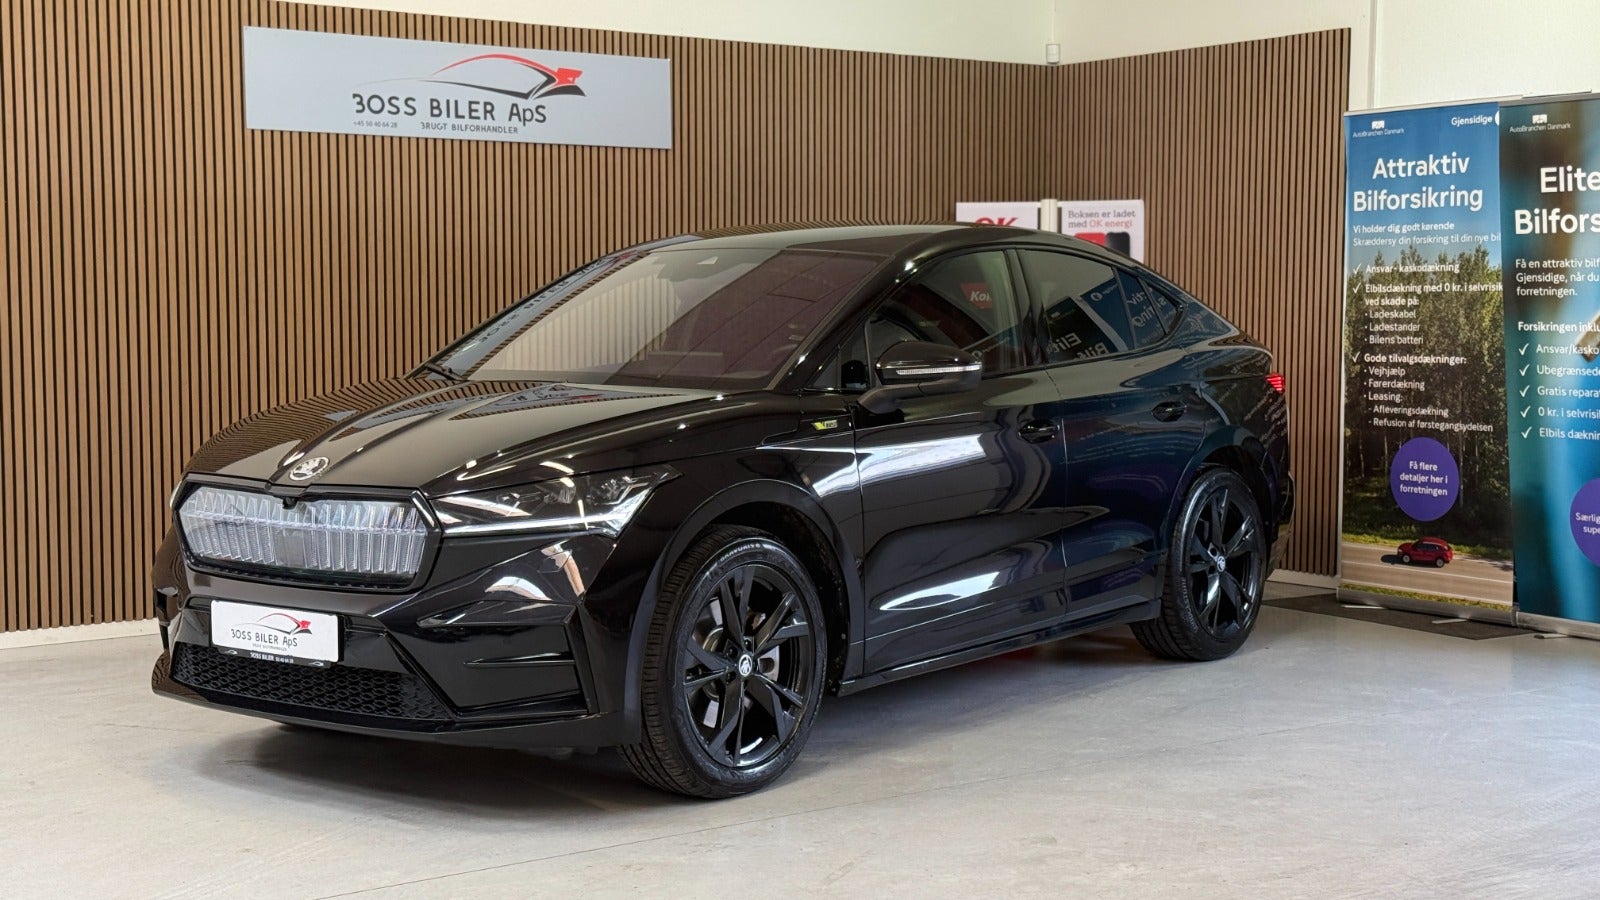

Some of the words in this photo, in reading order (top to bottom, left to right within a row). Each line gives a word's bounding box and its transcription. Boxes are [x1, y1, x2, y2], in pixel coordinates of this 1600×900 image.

[430, 98, 495, 121] BILER
[508, 103, 547, 127] ApS
[1451, 115, 1493, 127] Gjensidige
[452, 123, 518, 134] BILFORHANDLER
[1509, 125, 1546, 133] AutoBranchen
[1547, 123, 1571, 131] Danmark
[1372, 151, 1470, 179] Attraktiv
[1540, 165, 1600, 193] Elite
[1353, 185, 1483, 212] Bilforsikring
[1068, 210, 1099, 219] Boksen
[1113, 210, 1136, 218] ladet
[1068, 220, 1087, 228] med
[1089, 220, 1103, 228] OK
[1104, 220, 1133, 229] energi
[1514, 207, 1600, 235] Bilfors
[1353, 225, 1361, 233] Vi
[1362, 225, 1386, 233] holder
[1387, 224, 1400, 234] dig
[1401, 223, 1420, 234] godt
[1421, 222, 1455, 231] kørende
[1353, 237, 1396, 247] Skræddersy
[1412, 235, 1449, 245] forsikring
[1450, 234, 1459, 243] til
[1461, 233, 1473, 242] din
[1474, 235, 1489, 244] nye
[1399, 263, 1460, 274] kaskodækning
[1515, 259, 1527, 269] Få
[1528, 261, 1540, 269] en
[1542, 258, 1583, 269] attraktiv
[1515, 272, 1568, 285] Gjensidige,
[1569, 272, 1586, 282] når
[1587, 272, 1600, 282] du
[1365, 284, 1422, 294] Elbilsdækning
[1423, 283, 1442, 292] med
[1444, 283, 1450, 292] 0
[1452, 283, 1463, 292] kr.
[1516, 286, 1578, 298] forretningen.
[1365, 297, 1380, 306] ved
[1381, 297, 1405, 306] skade
[1407, 296, 1420, 307] på:
[1369, 310, 1416, 319] Ladeskabel
[1369, 323, 1420, 332] Ladestander
[1517, 321, 1577, 334] Forsikringen
[1369, 335, 1395, 344] Bilens
[1396, 335, 1424, 345] batteri
[1536, 344, 1599, 355] Ansvar/kasko
[1364, 353, 1387, 363] Gode
[1388, 353, 1467, 366] tilvalgsdækninger:
[1368, 366, 1406, 377] Vejhjælp
[1536, 365, 1600, 377] Ubegrænsed
[1368, 379, 1425, 391] Førerdækning
[1537, 386, 1567, 397] Gratis
[1373, 405, 1449, 418] Afleveringsdækning
[1538, 406, 1545, 417] 0
[1547, 407, 1559, 417] kr.
[1373, 417, 1407, 427] Refusion
[1407, 419, 1416, 428] af
[1539, 428, 1566, 439] Elbils
[1409, 461, 1418, 470] Få
[1419, 461, 1438, 471] flere
[1400, 472, 1429, 484] detaljer
[1430, 474, 1444, 483] her
[1400, 484, 1448, 497] forretningen
[255, 632, 279, 645] BILER
[282, 636, 298, 648] ApS
